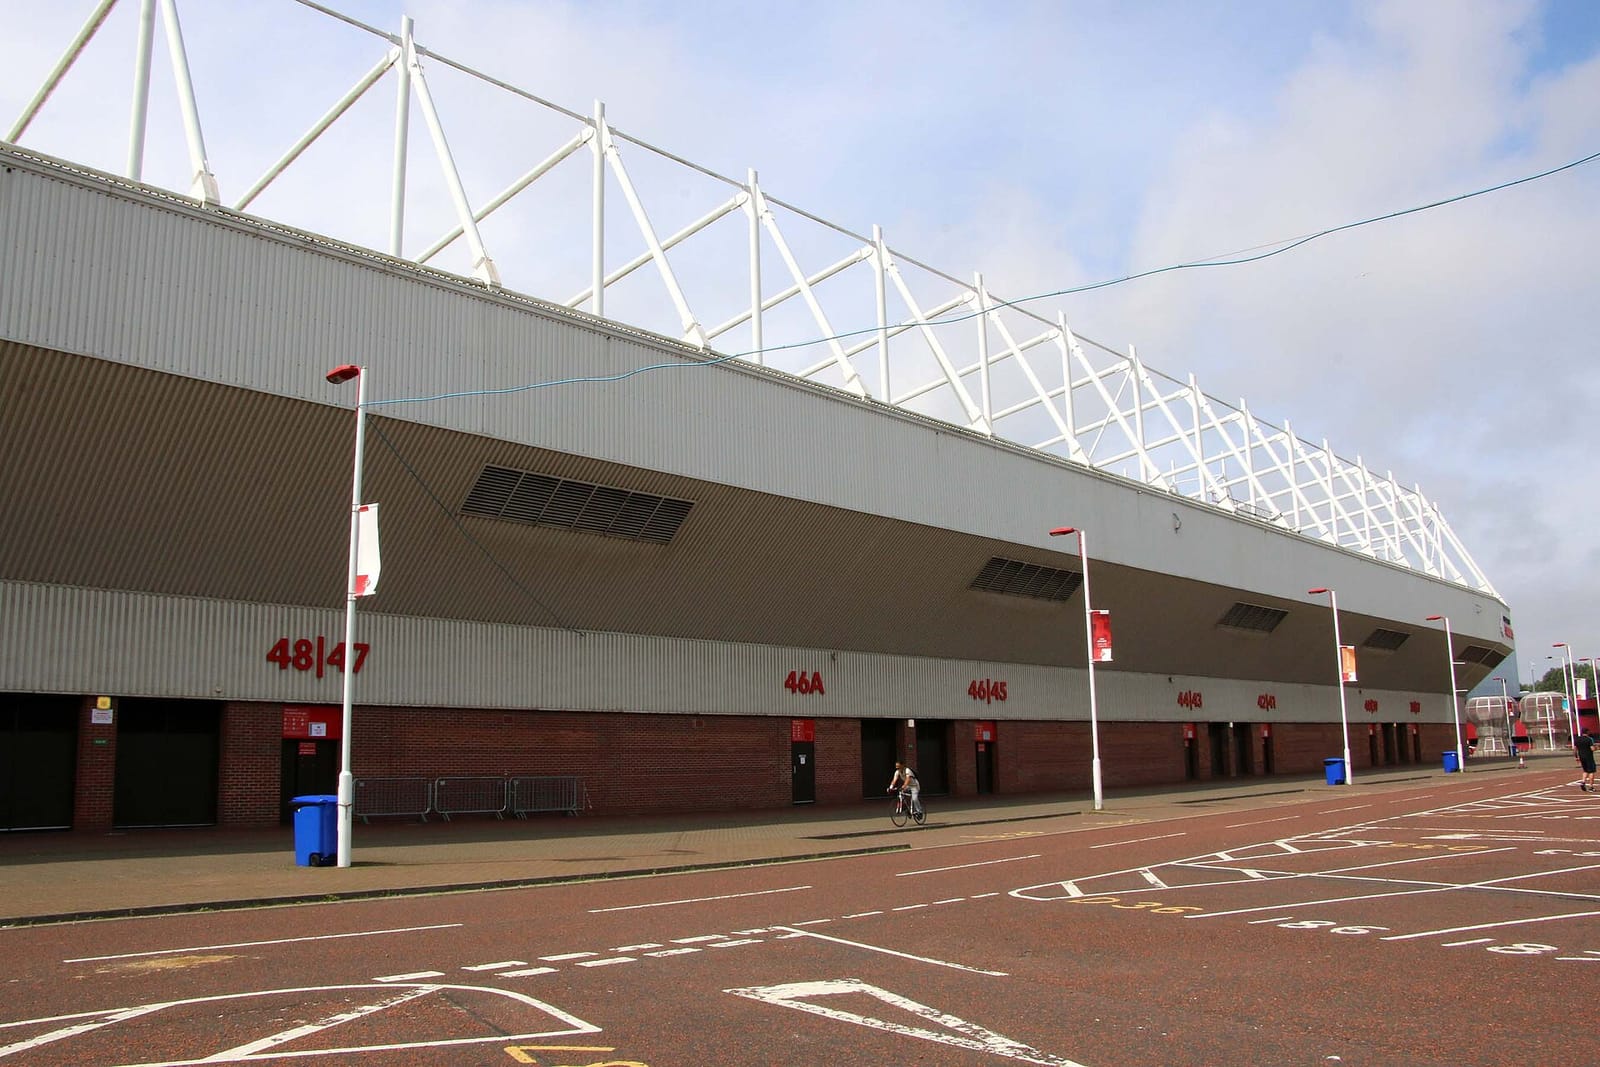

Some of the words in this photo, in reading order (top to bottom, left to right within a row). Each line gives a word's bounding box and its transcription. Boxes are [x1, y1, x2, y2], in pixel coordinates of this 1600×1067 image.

[784, 671, 825, 696] 46A
[1066, 896, 1204, 914] D36
[1247, 916, 1391, 935] 186
